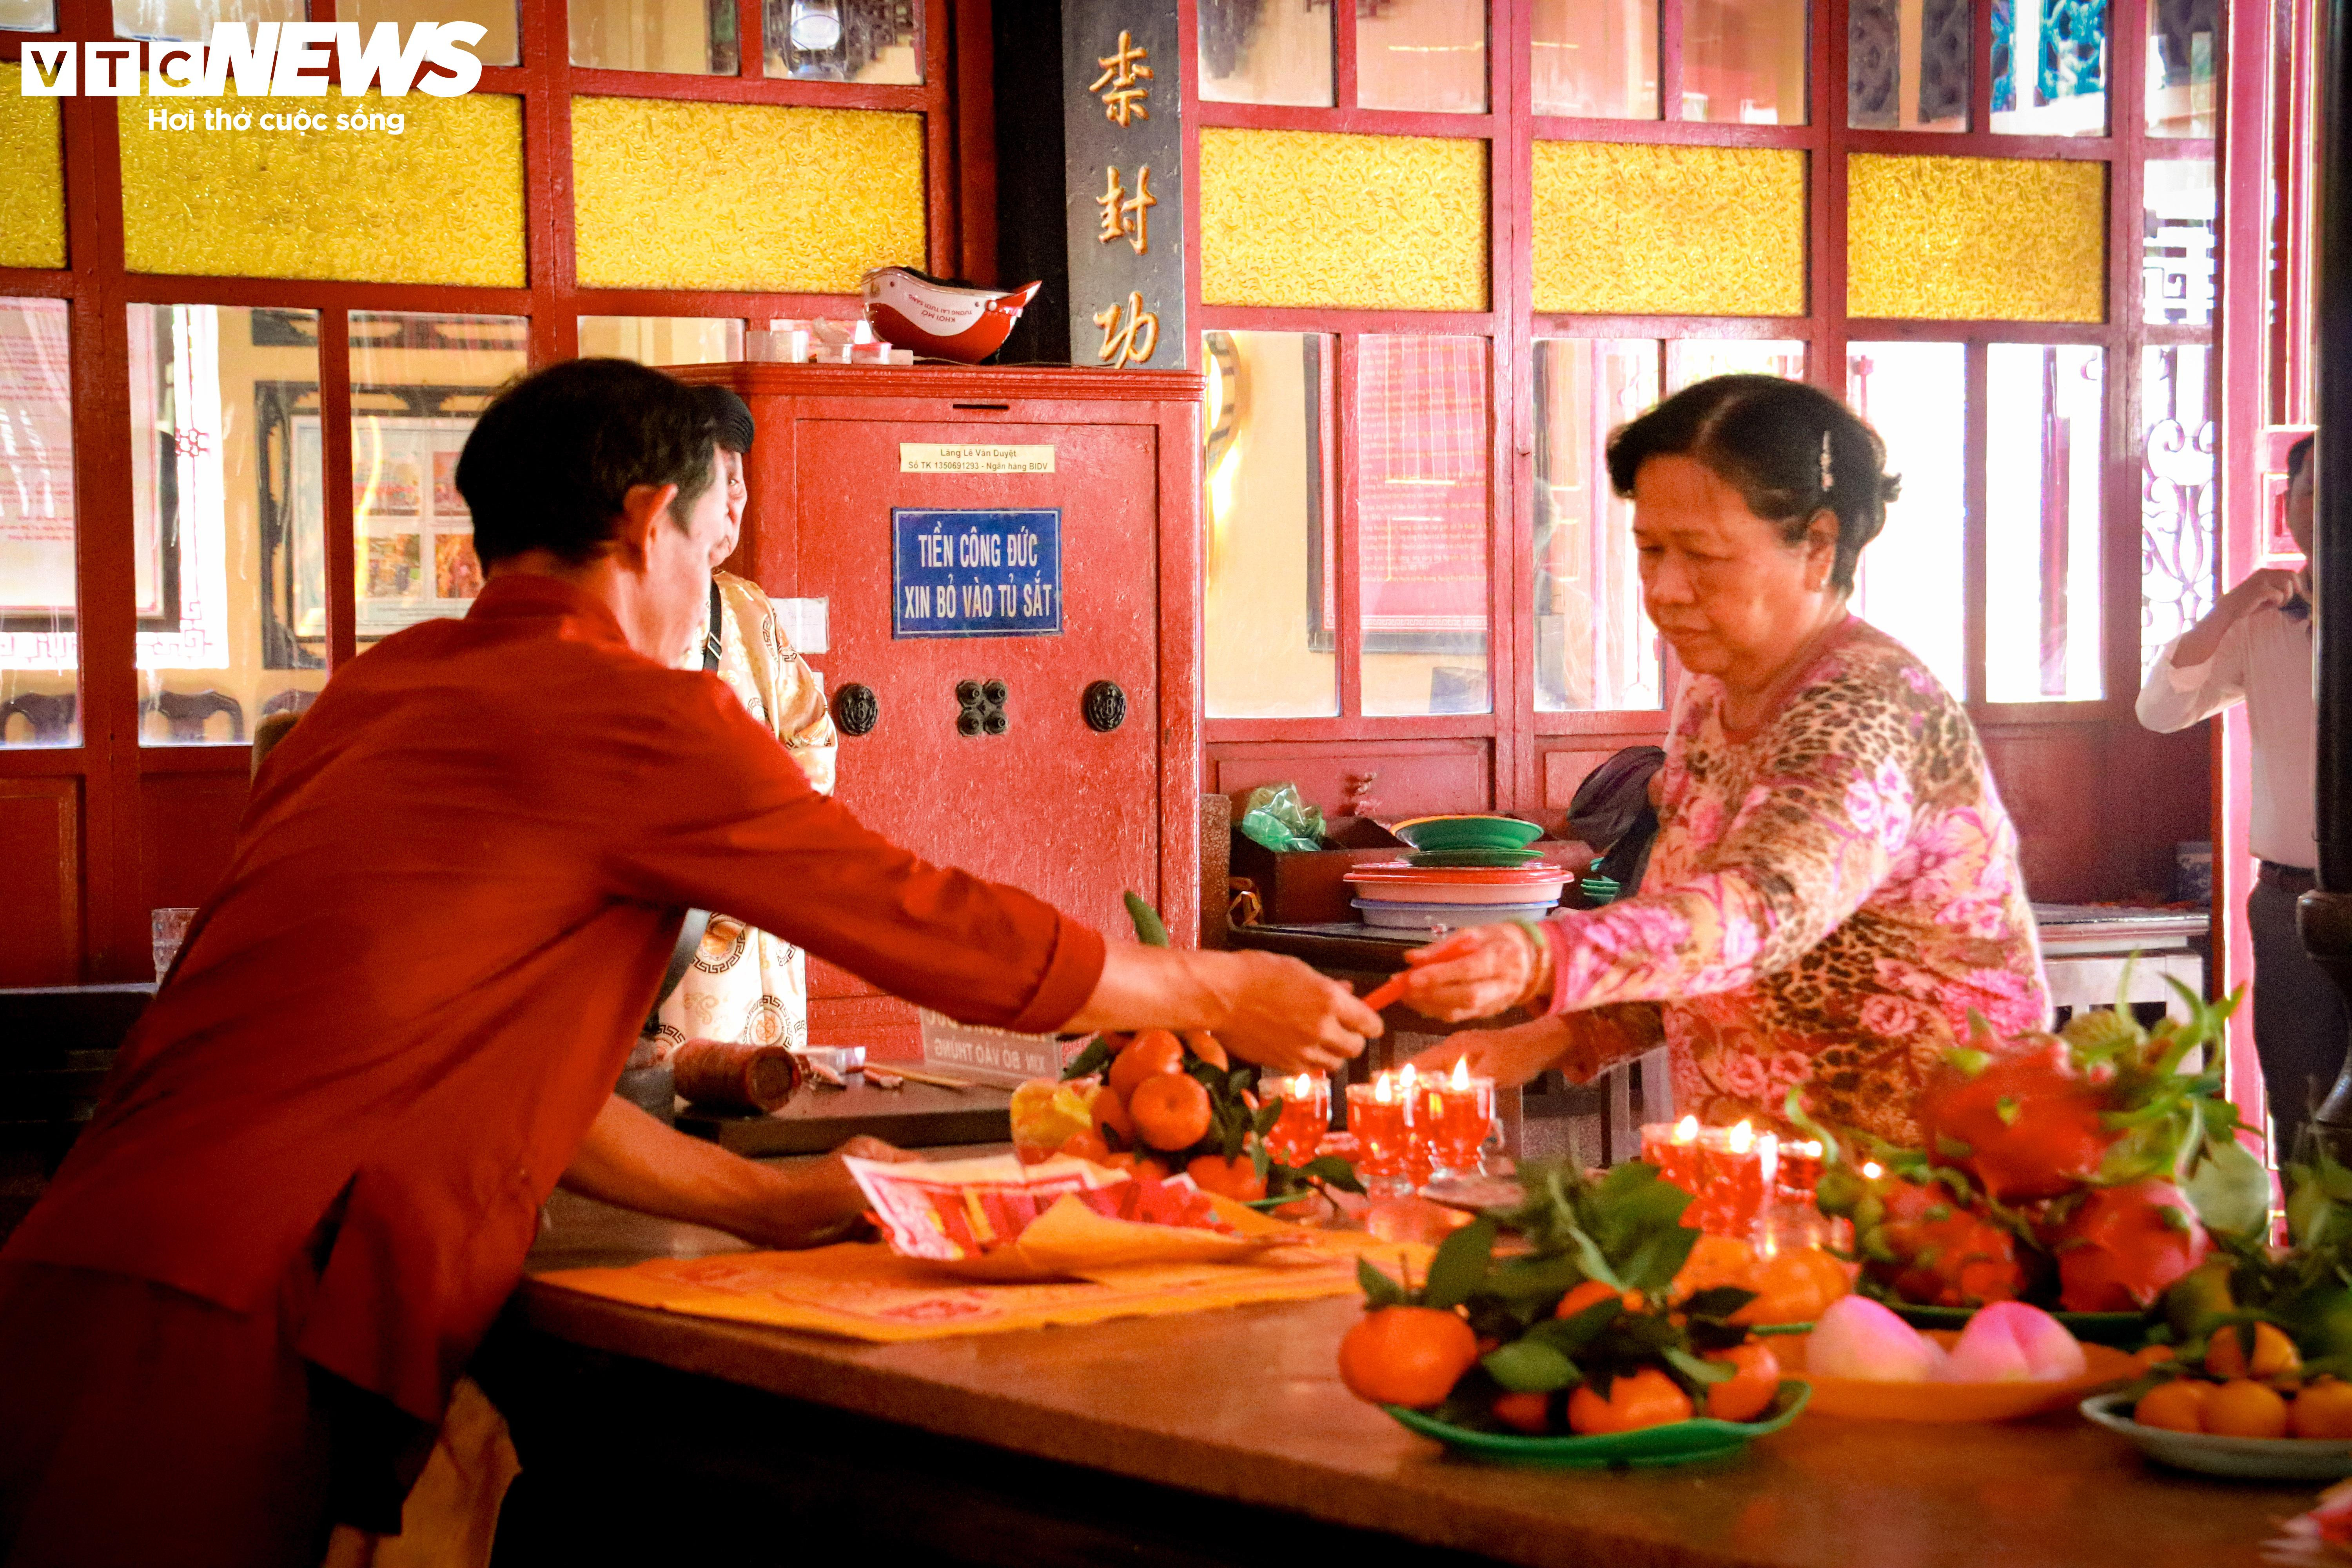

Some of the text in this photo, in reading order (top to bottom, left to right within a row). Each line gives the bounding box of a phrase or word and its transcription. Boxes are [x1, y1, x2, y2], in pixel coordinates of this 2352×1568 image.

[908, 460, 918, 469] Số
[986, 462, 1005, 471] Ngân
[1008, 463, 1027, 472] hàng
[940, 449, 961, 458] Lăng
[994, 449, 1016, 459] Duyệt
[918, 521, 1038, 568] TIỀN CÔNG ĐỨC
[904, 570, 1052, 618] XIN BỎ VÀO TỦ SẮT
